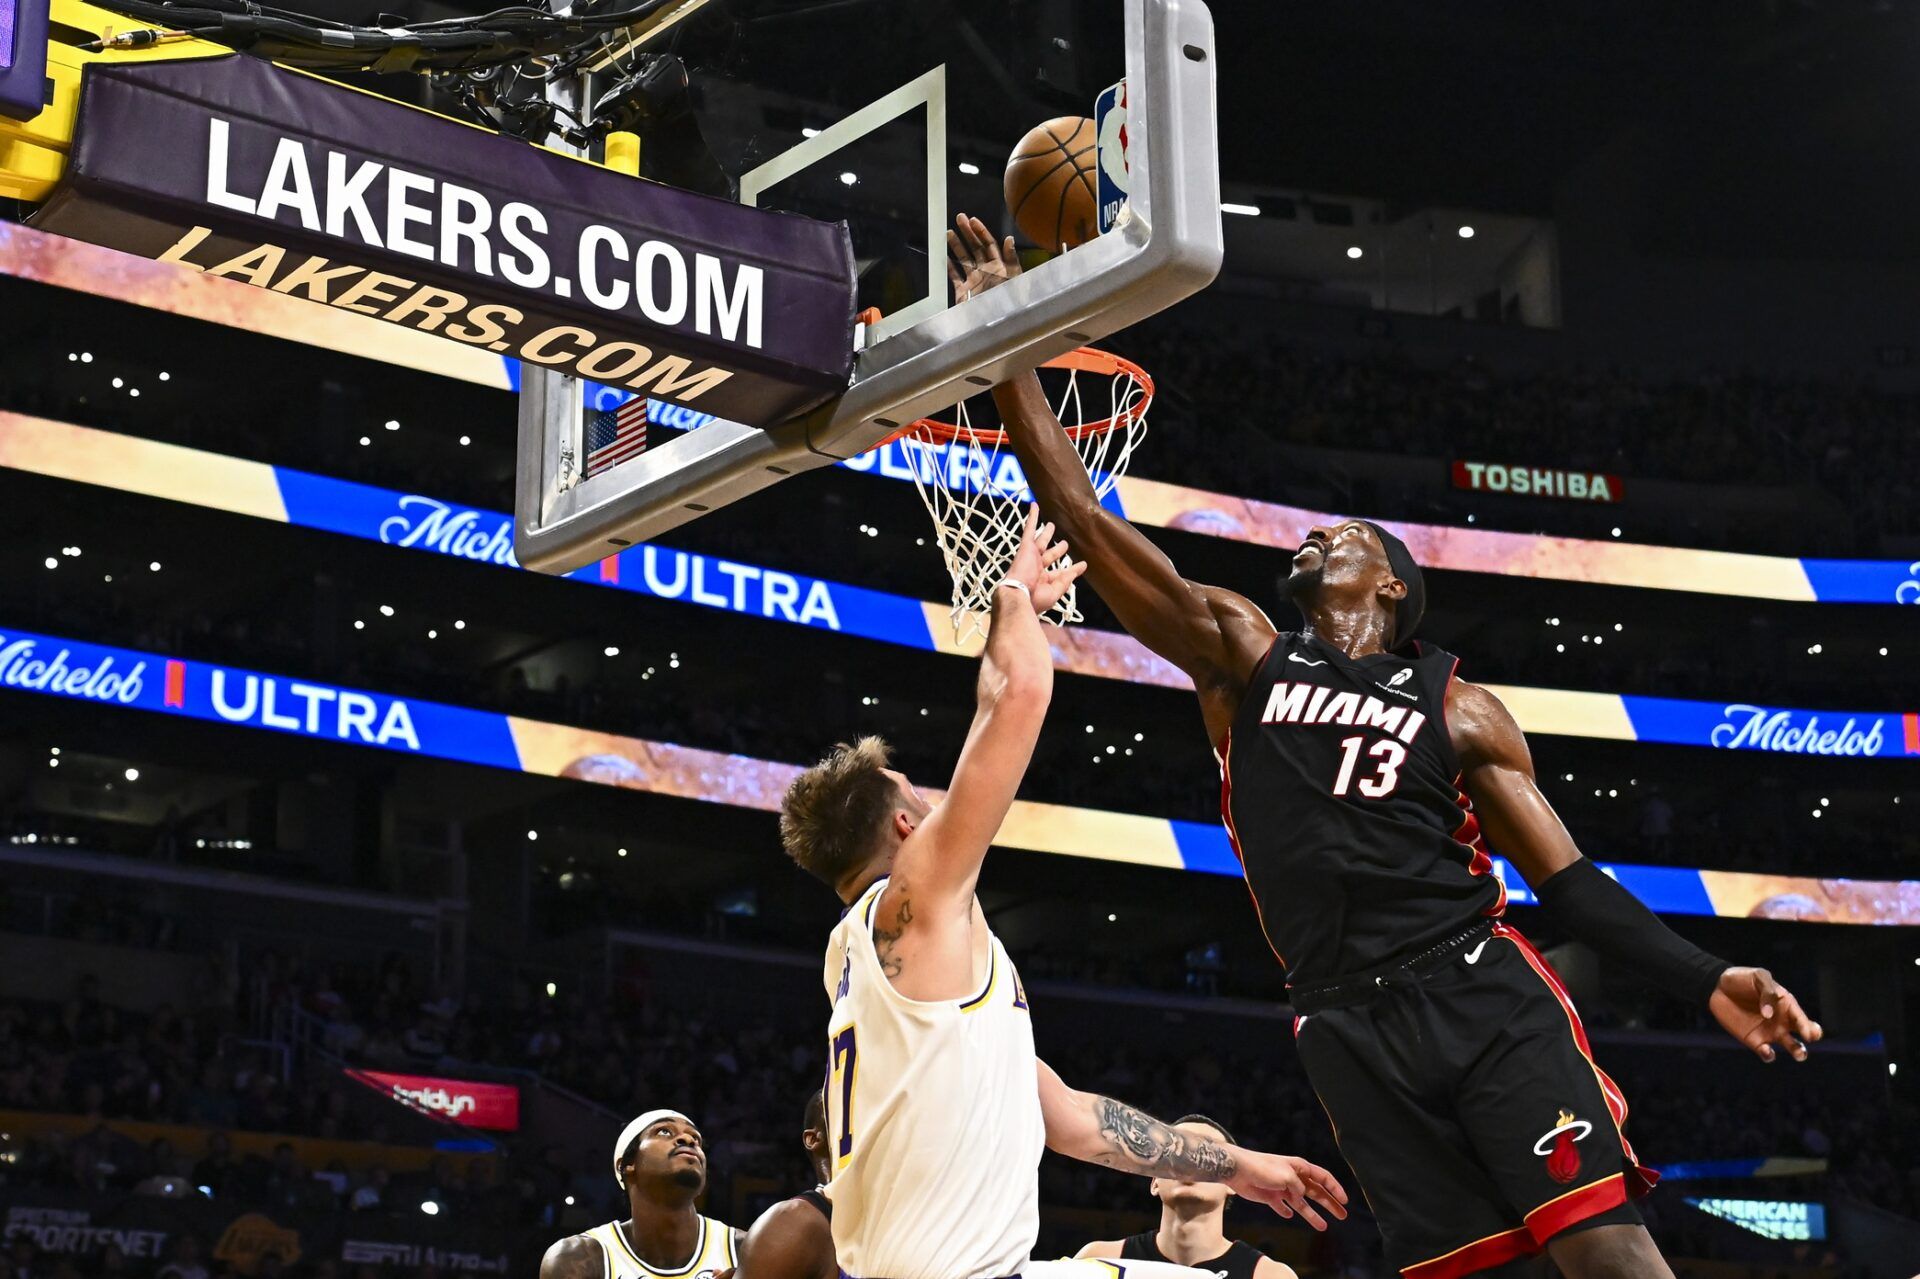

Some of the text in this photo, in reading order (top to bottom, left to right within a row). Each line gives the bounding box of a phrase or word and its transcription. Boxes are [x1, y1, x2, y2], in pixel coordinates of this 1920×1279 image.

[207, 118, 765, 349] LAKERS.COM
[154, 226, 735, 402] LAKERS.COM
[1464, 462, 1612, 501] TOSHIBA
[643, 546, 841, 630] ULTRA
[211, 668, 421, 750] ULTRA
[1261, 682, 1426, 744] MIAMI
[1711, 703, 1885, 757] Michelob
[1332, 736, 1406, 798] 13
[821, 1023, 859, 1170] 7
